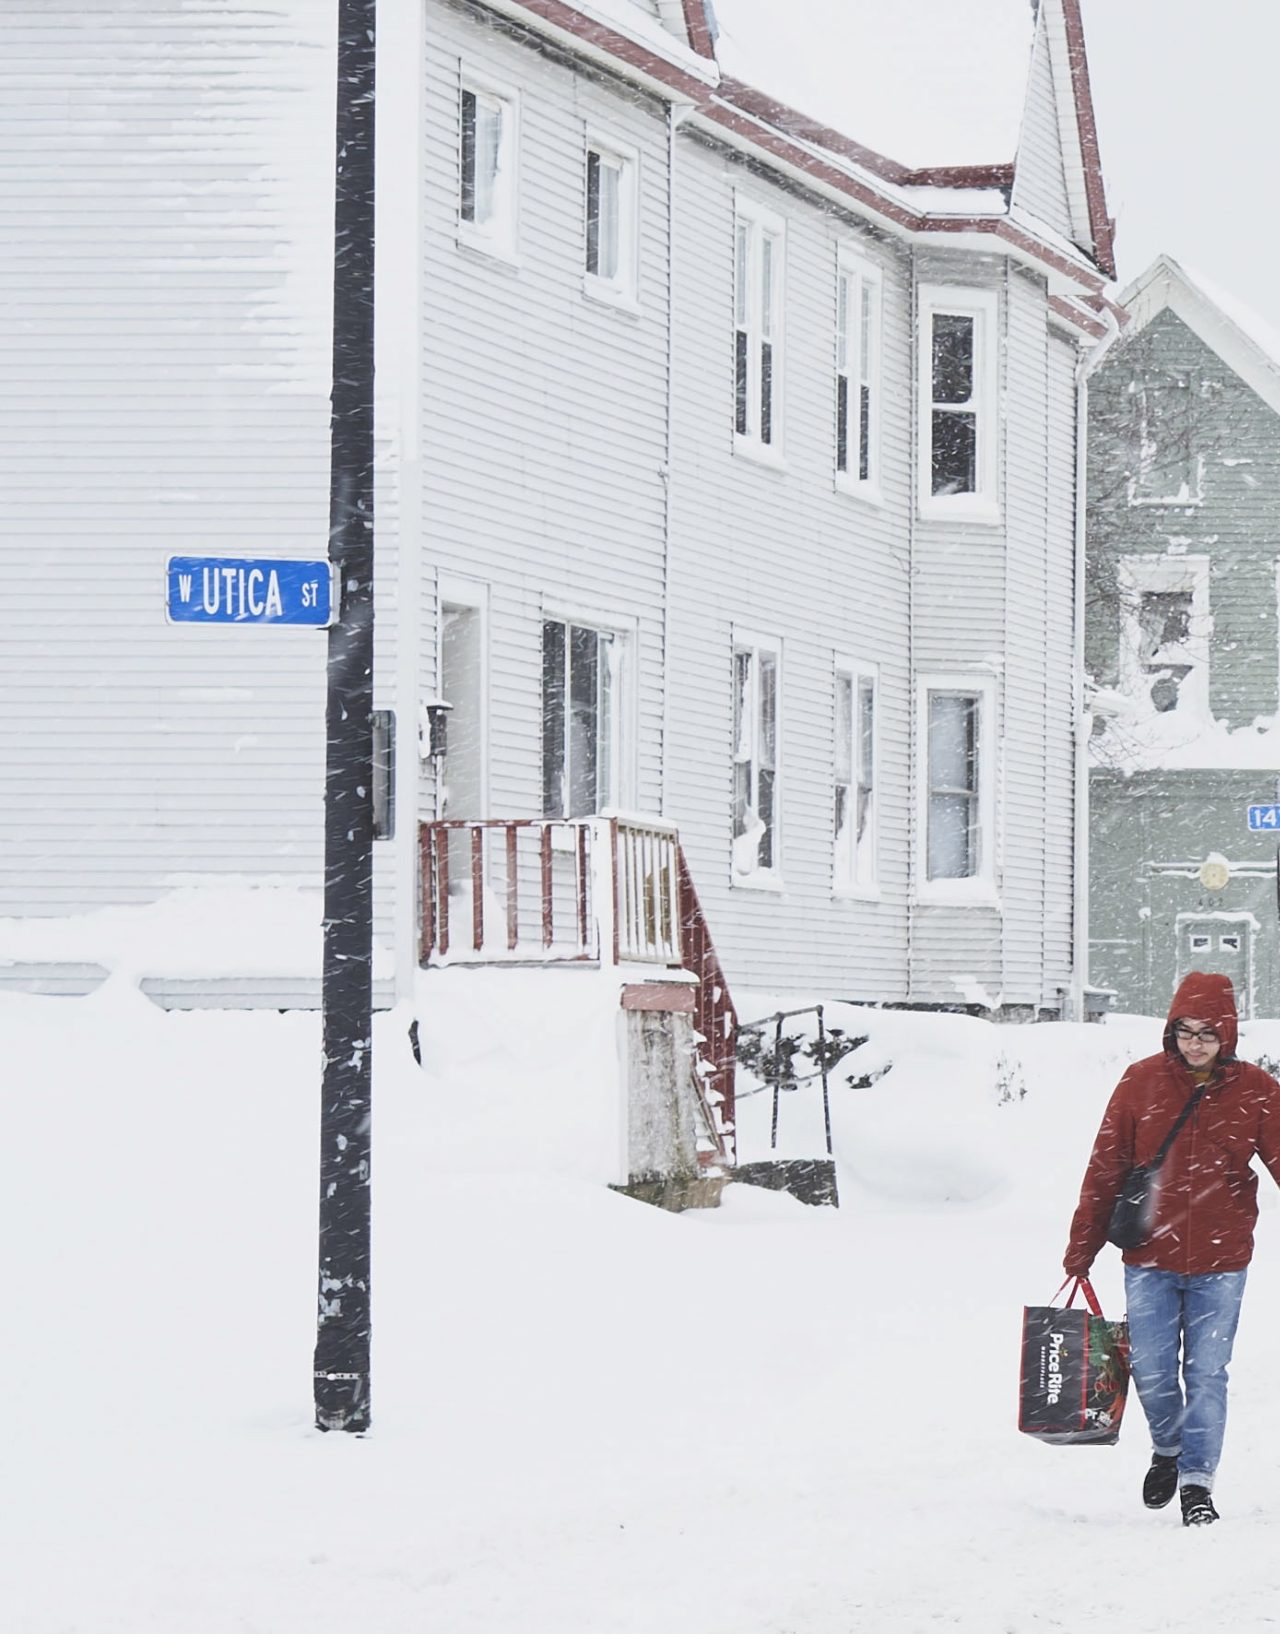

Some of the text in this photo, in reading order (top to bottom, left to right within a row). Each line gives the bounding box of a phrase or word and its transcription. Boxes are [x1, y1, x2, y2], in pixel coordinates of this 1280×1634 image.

[178, 567, 319, 617] W UTICA ST
[1047, 1333, 1064, 1404] Price Rite
